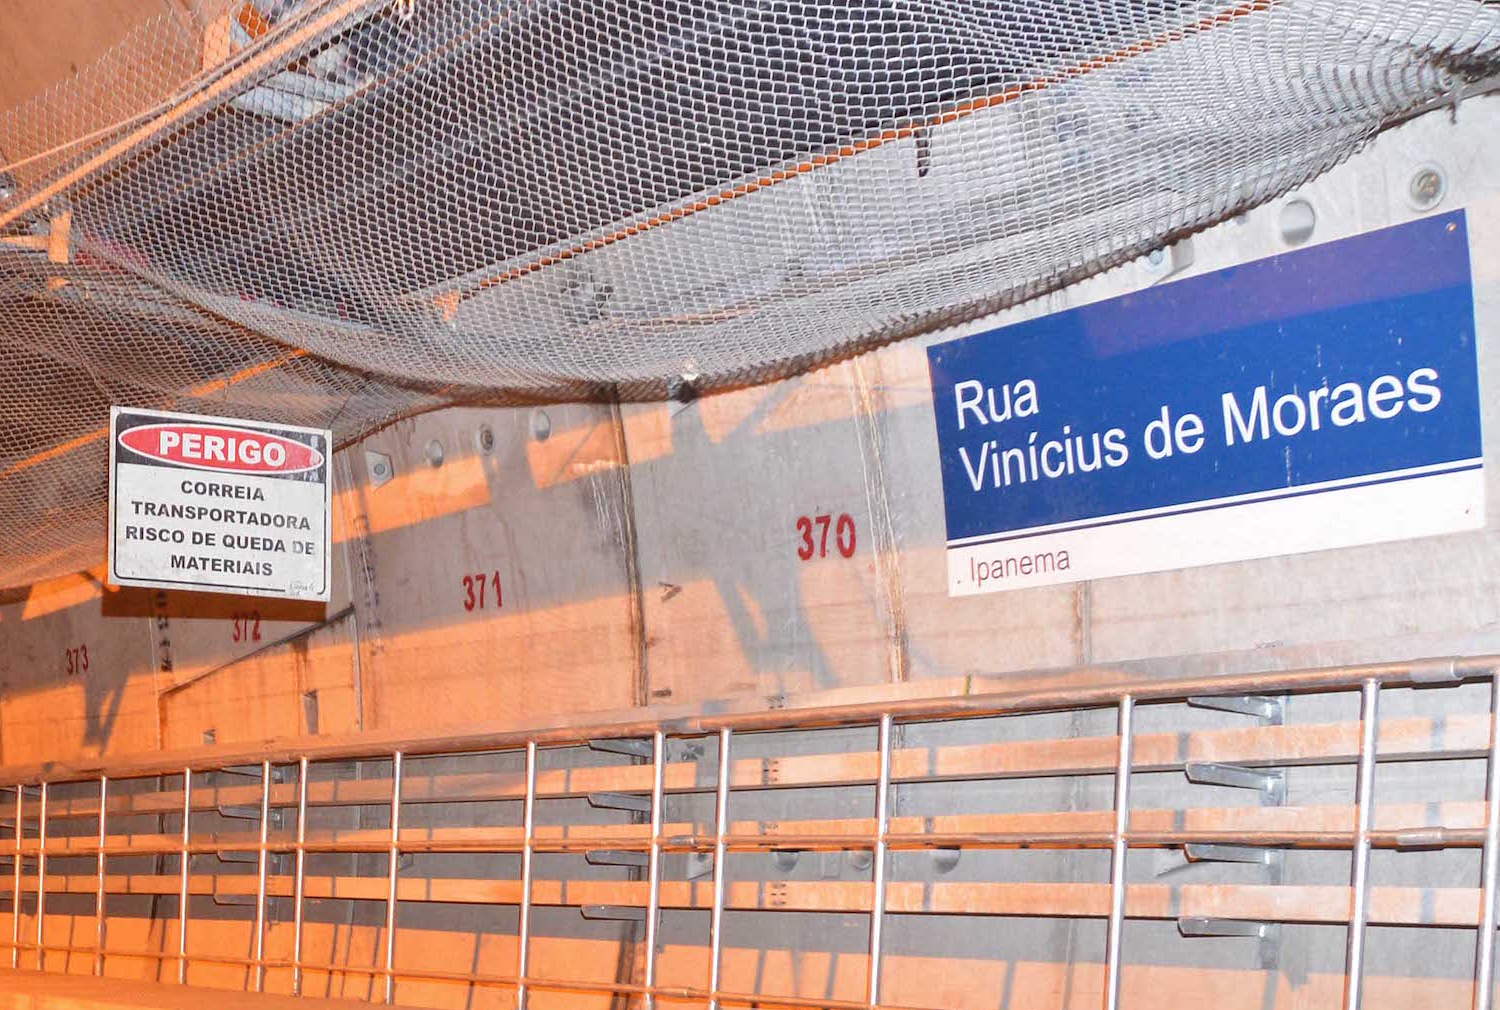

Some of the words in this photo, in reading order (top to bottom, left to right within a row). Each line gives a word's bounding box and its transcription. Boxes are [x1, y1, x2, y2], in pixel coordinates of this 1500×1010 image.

[954, 377, 1040, 431] Rua
[958, 426, 1130, 493] Vinícius
[1143, 404, 1205, 460] de
[1221, 365, 1443, 447] Moraes
[159, 430, 287, 467] PERIGO
[180, 479, 266, 502] CORREIA
[130, 500, 311, 531] TRANSPORTADORA
[125, 525, 186, 544] RISCO
[191, 530, 216, 547] DE
[221, 534, 287, 554] QUEDA
[291, 539, 316, 556] DE
[796, 512, 858, 561] 370
[170, 554, 274, 577] MATERIAIS
[969, 546, 1071, 584] Ipanema
[462, 569, 503, 613] 371
[65, 643, 90, 676] 373
